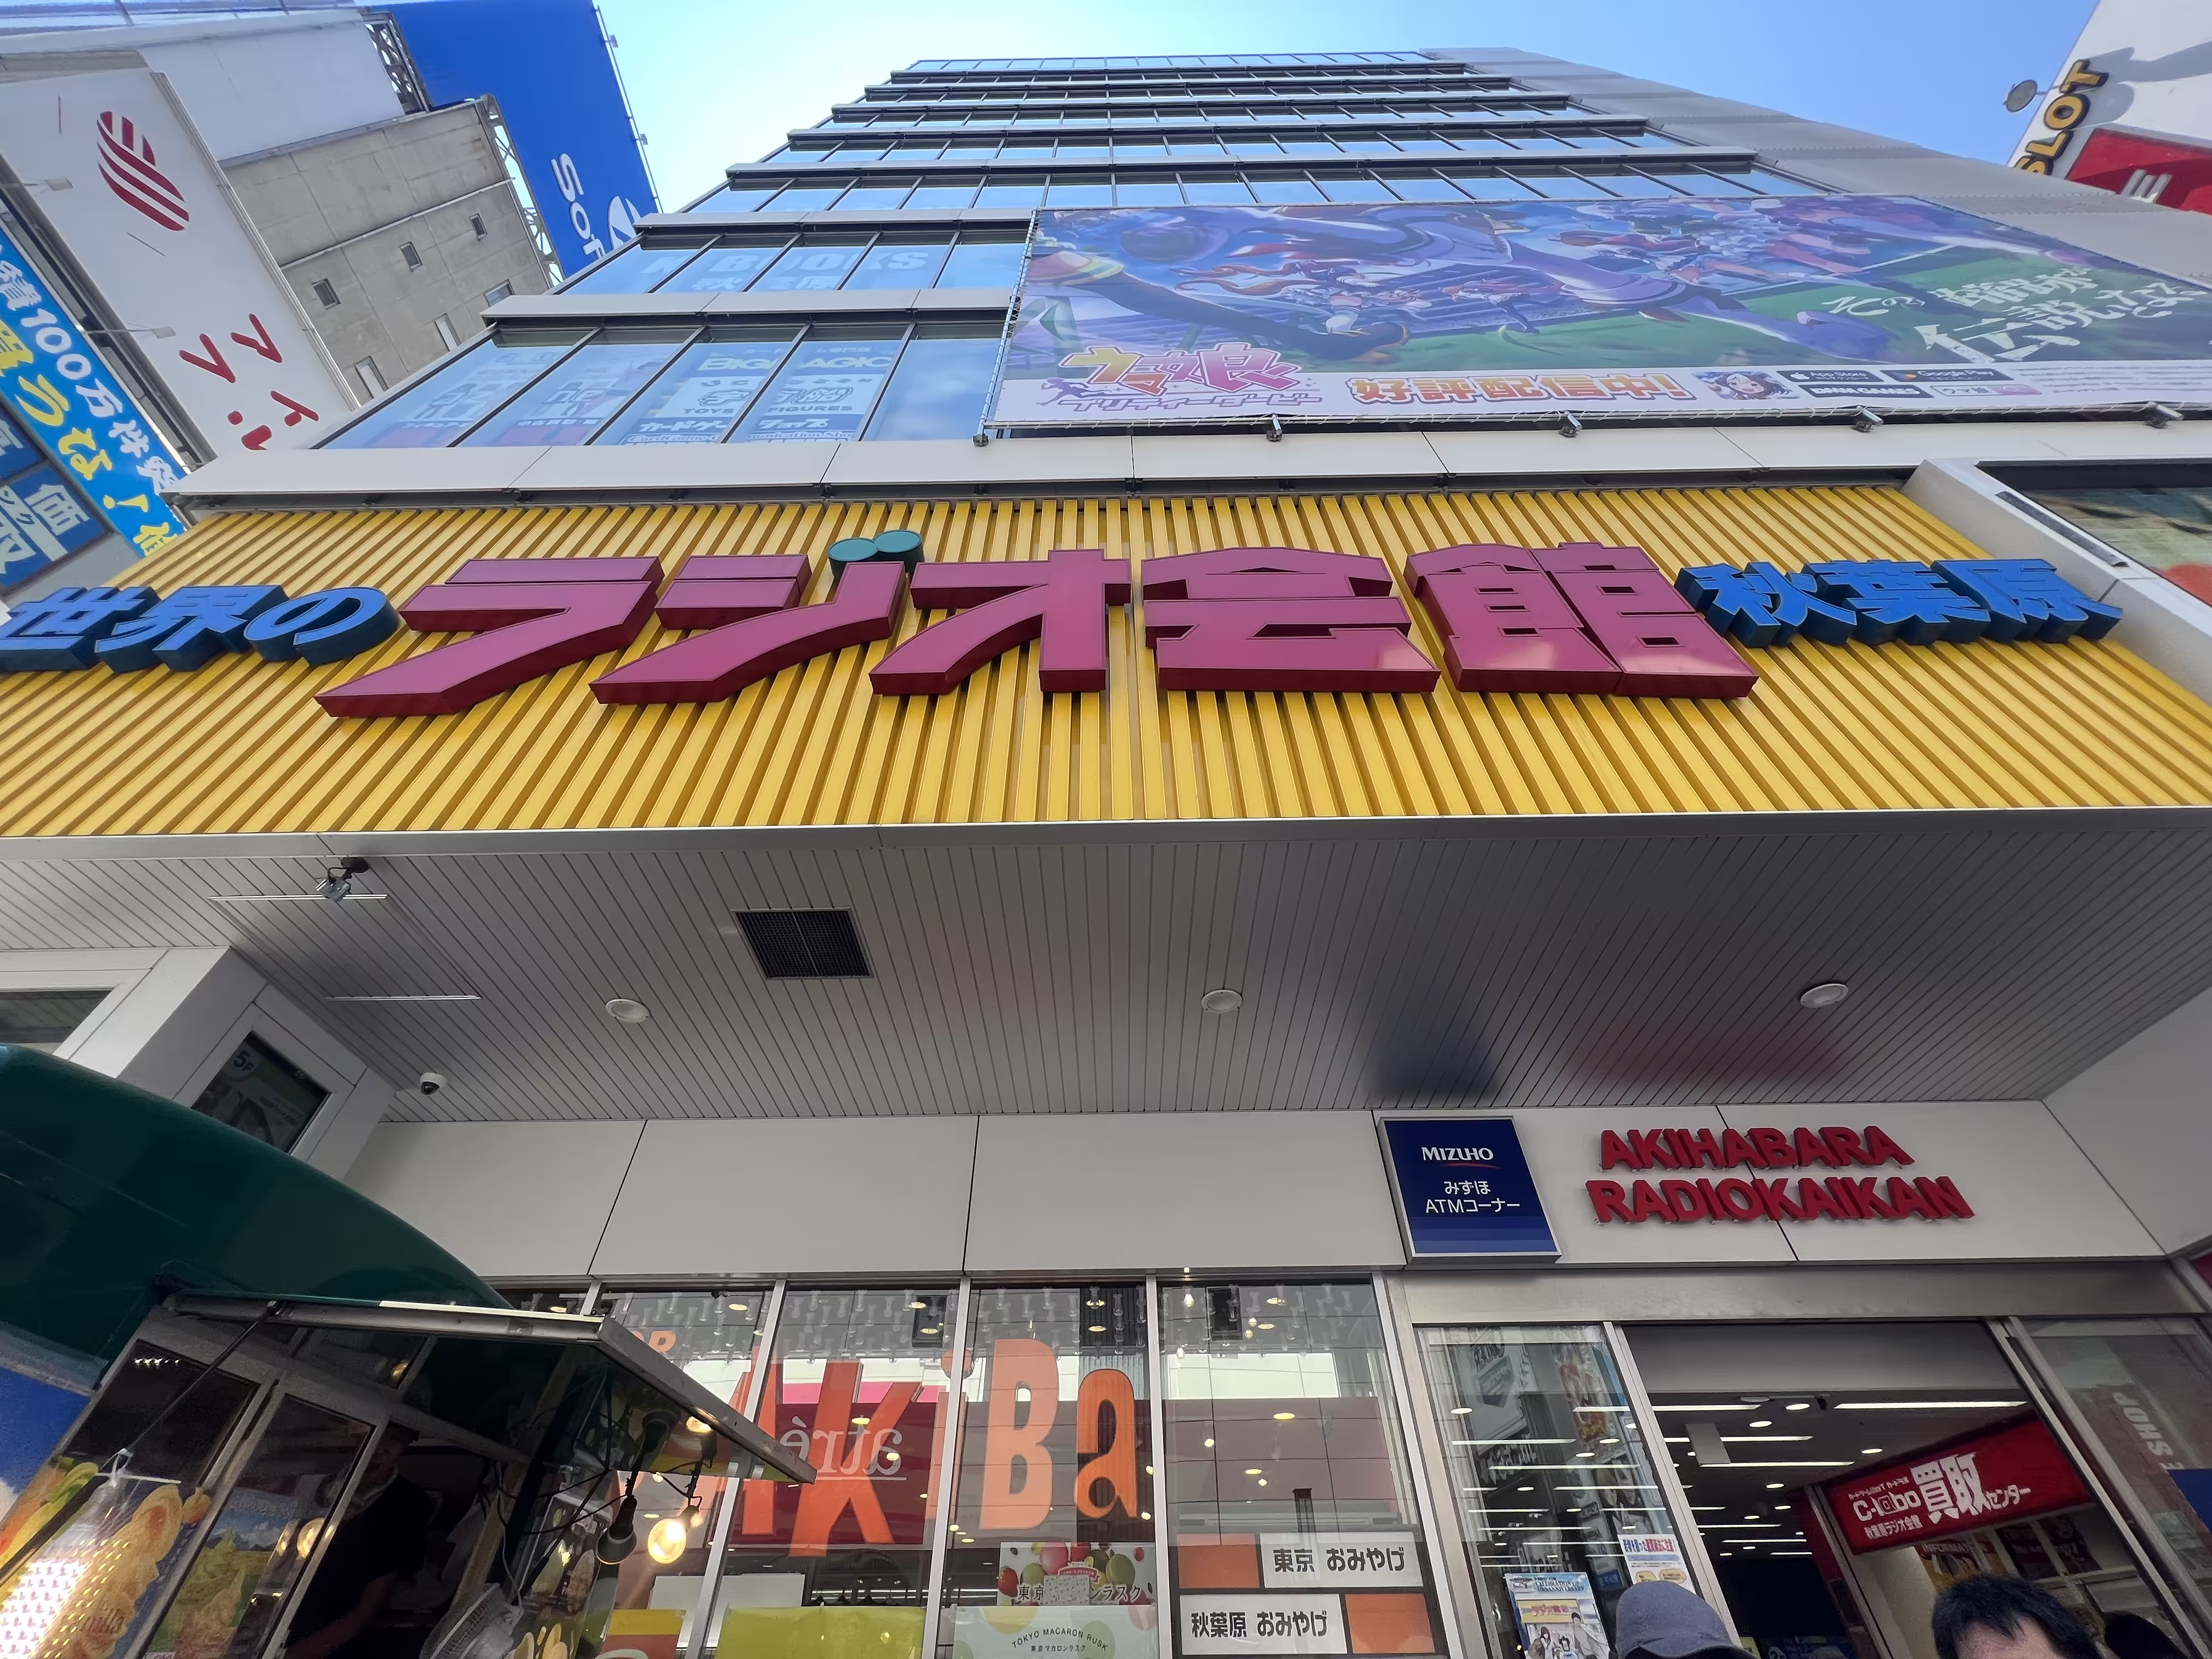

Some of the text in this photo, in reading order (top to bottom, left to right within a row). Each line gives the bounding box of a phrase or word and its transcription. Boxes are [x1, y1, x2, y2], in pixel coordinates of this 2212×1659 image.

[2013, 58, 2109, 176] SLOT
[230, 313, 319, 422] アイ
[1059, 342, 1301, 396] ウマ娘
[1347, 373, 1696, 404] 好評配信中!
[233, 1048, 255, 1072] 5F
[1421, 1147, 1494, 1161] MIZUHO
[1599, 1125, 1914, 1172] AKIHABARA
[1444, 1180, 1491, 1195] みずほ
[1585, 1176, 1974, 1225] RADIOKAIKAN
[1425, 1199, 1520, 1215] ATMコーナー
[1910, 1452, 2032, 1525] 買取センター
[1273, 1547, 1406, 1572] 東京 おみやげ
[1017, 1584, 1142, 1602] 東京ンラスク
[1190, 1610, 1328, 1638] 秋葉原 おみやげ
[1012, 1628, 1108, 1651] TOKYO MACARON RUSK
